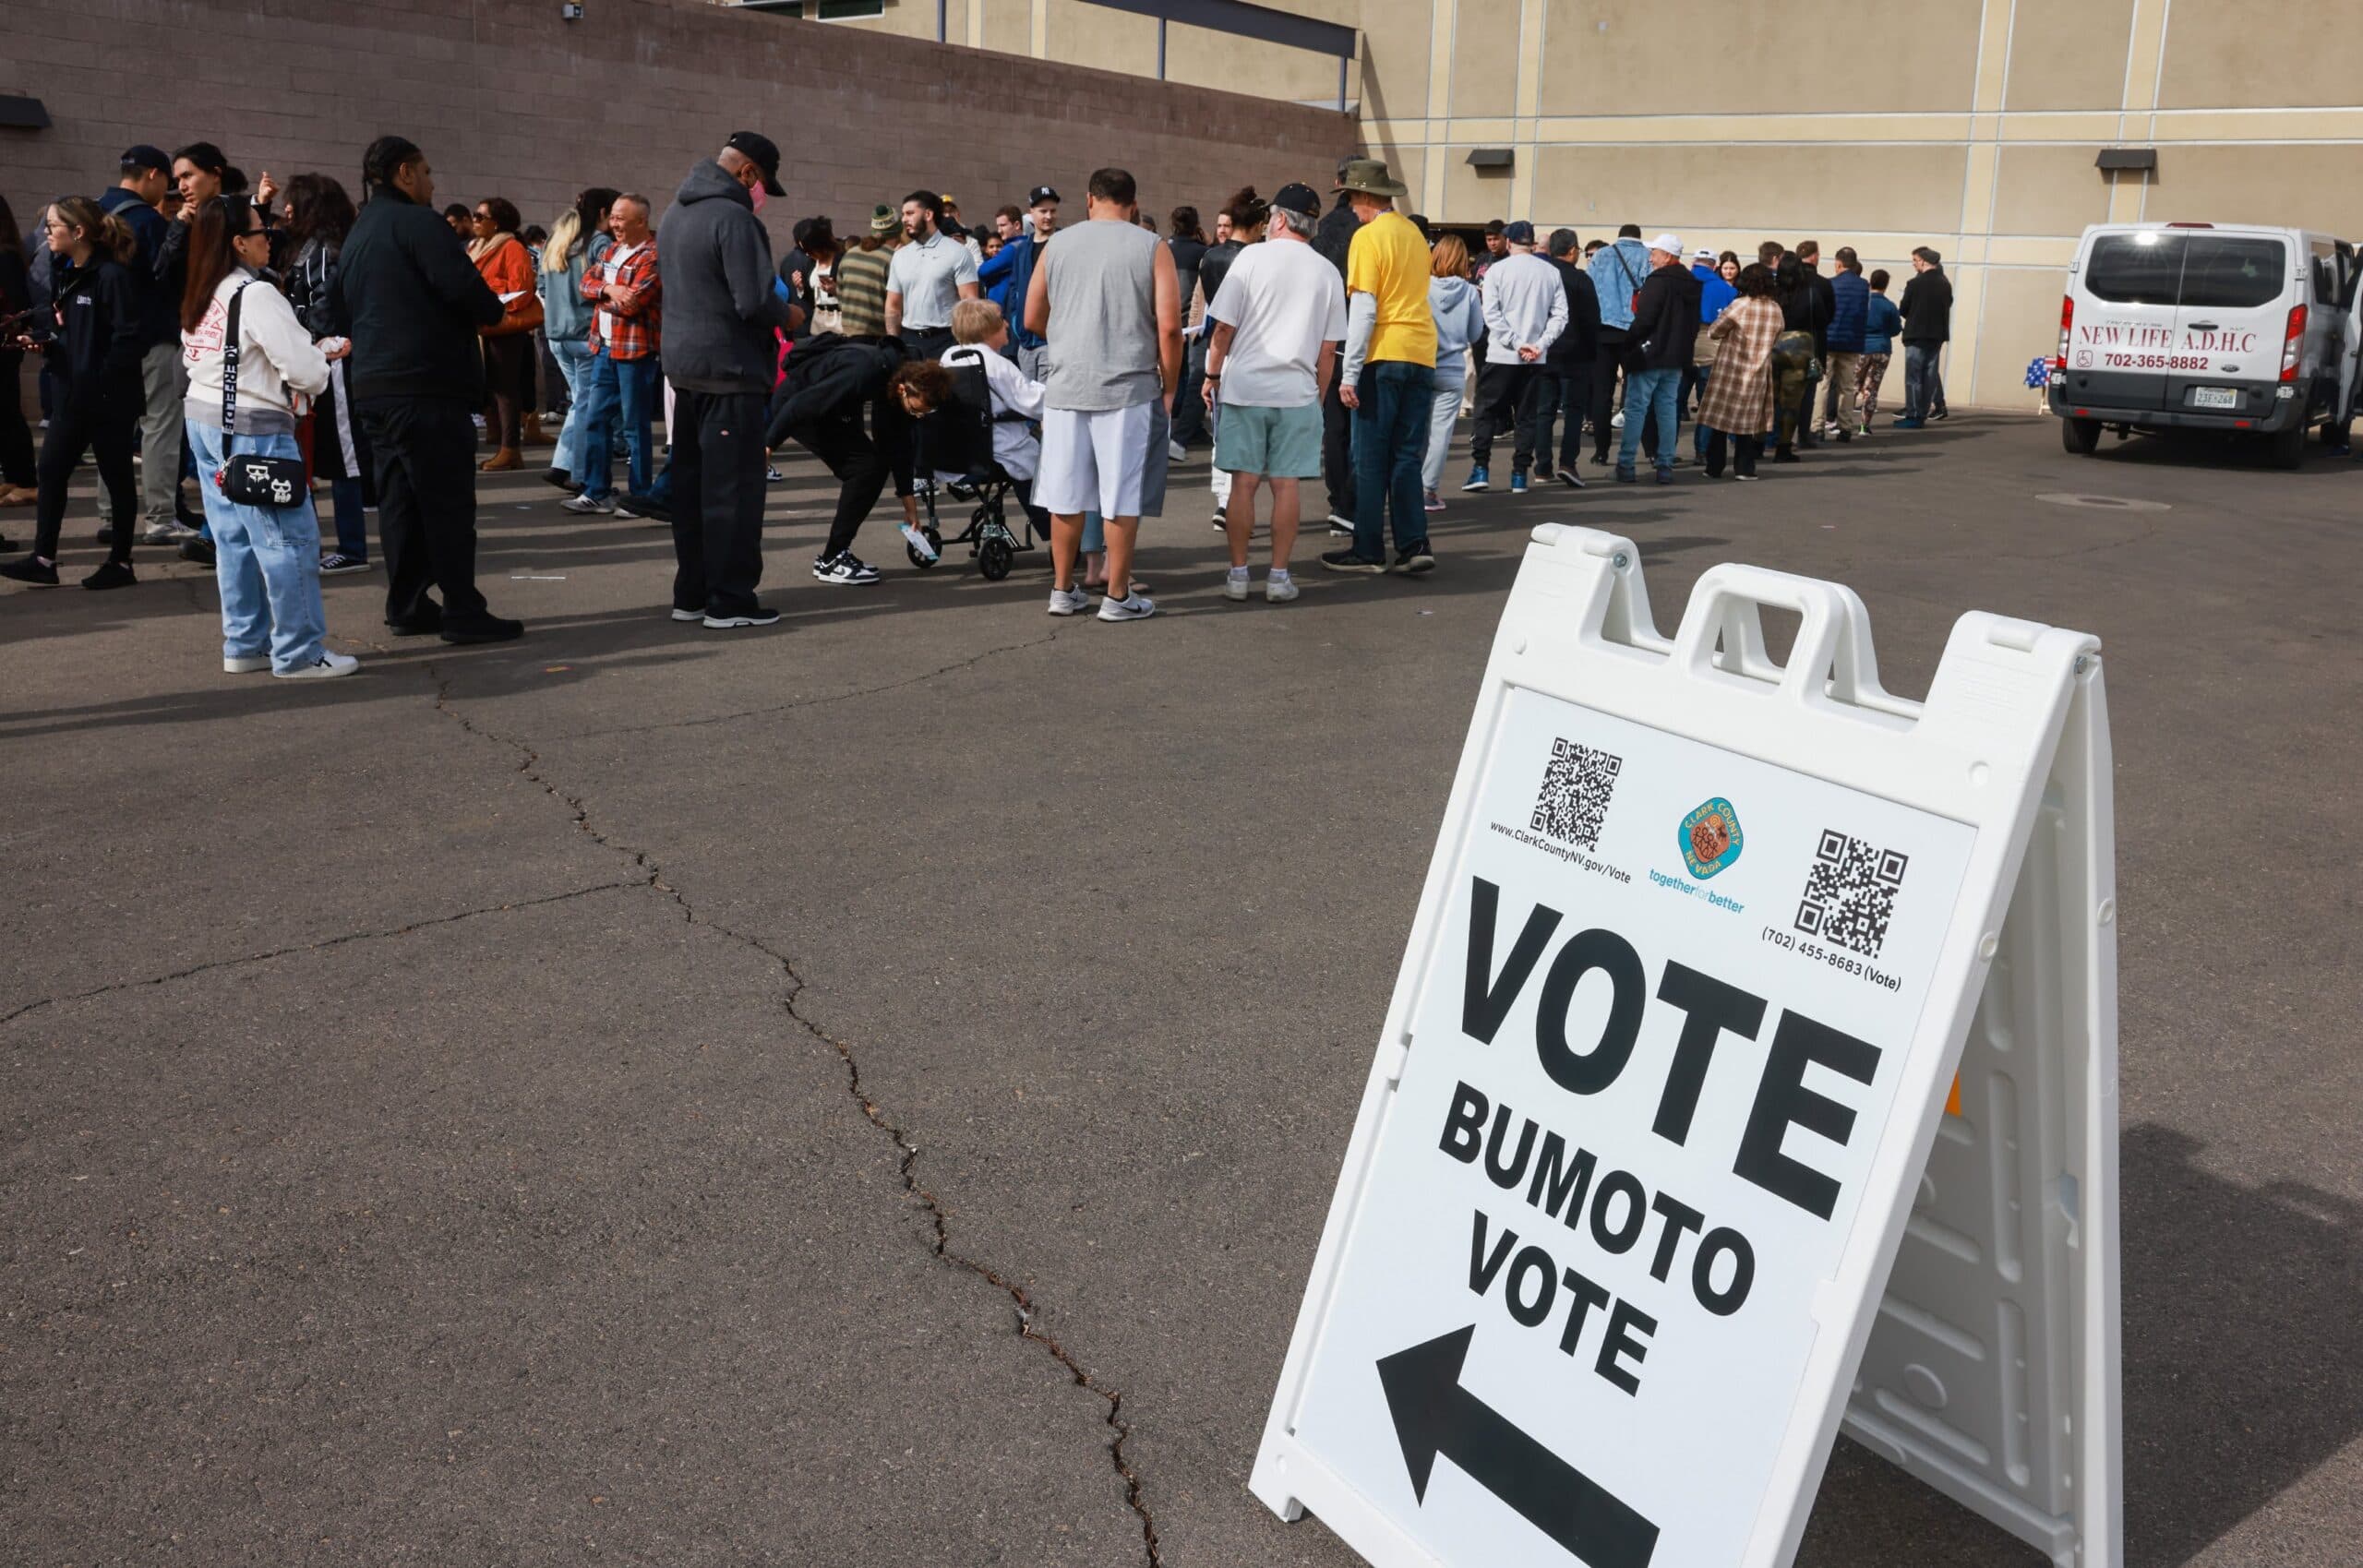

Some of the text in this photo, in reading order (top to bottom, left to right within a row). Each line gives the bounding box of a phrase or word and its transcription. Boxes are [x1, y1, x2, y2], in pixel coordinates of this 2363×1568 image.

[2079, 326, 2124, 346] NEW
[2128, 328, 2173, 348] LIFE
[2105, 353, 2209, 370] 702-365-8882
[1491, 820, 1631, 884] www.ClarkCountyNV.gov/Vote
[1685, 802, 1741, 845] CLARK COUNTY
[1686, 851, 1722, 875] NEVADA
[1762, 927, 1901, 993] (702) 455-8683 (Vote)
[1461, 875, 1883, 1222] VOTE
[1438, 1080, 1756, 1317] BUMOTO
[1469, 1209, 1659, 1397] VOTE
